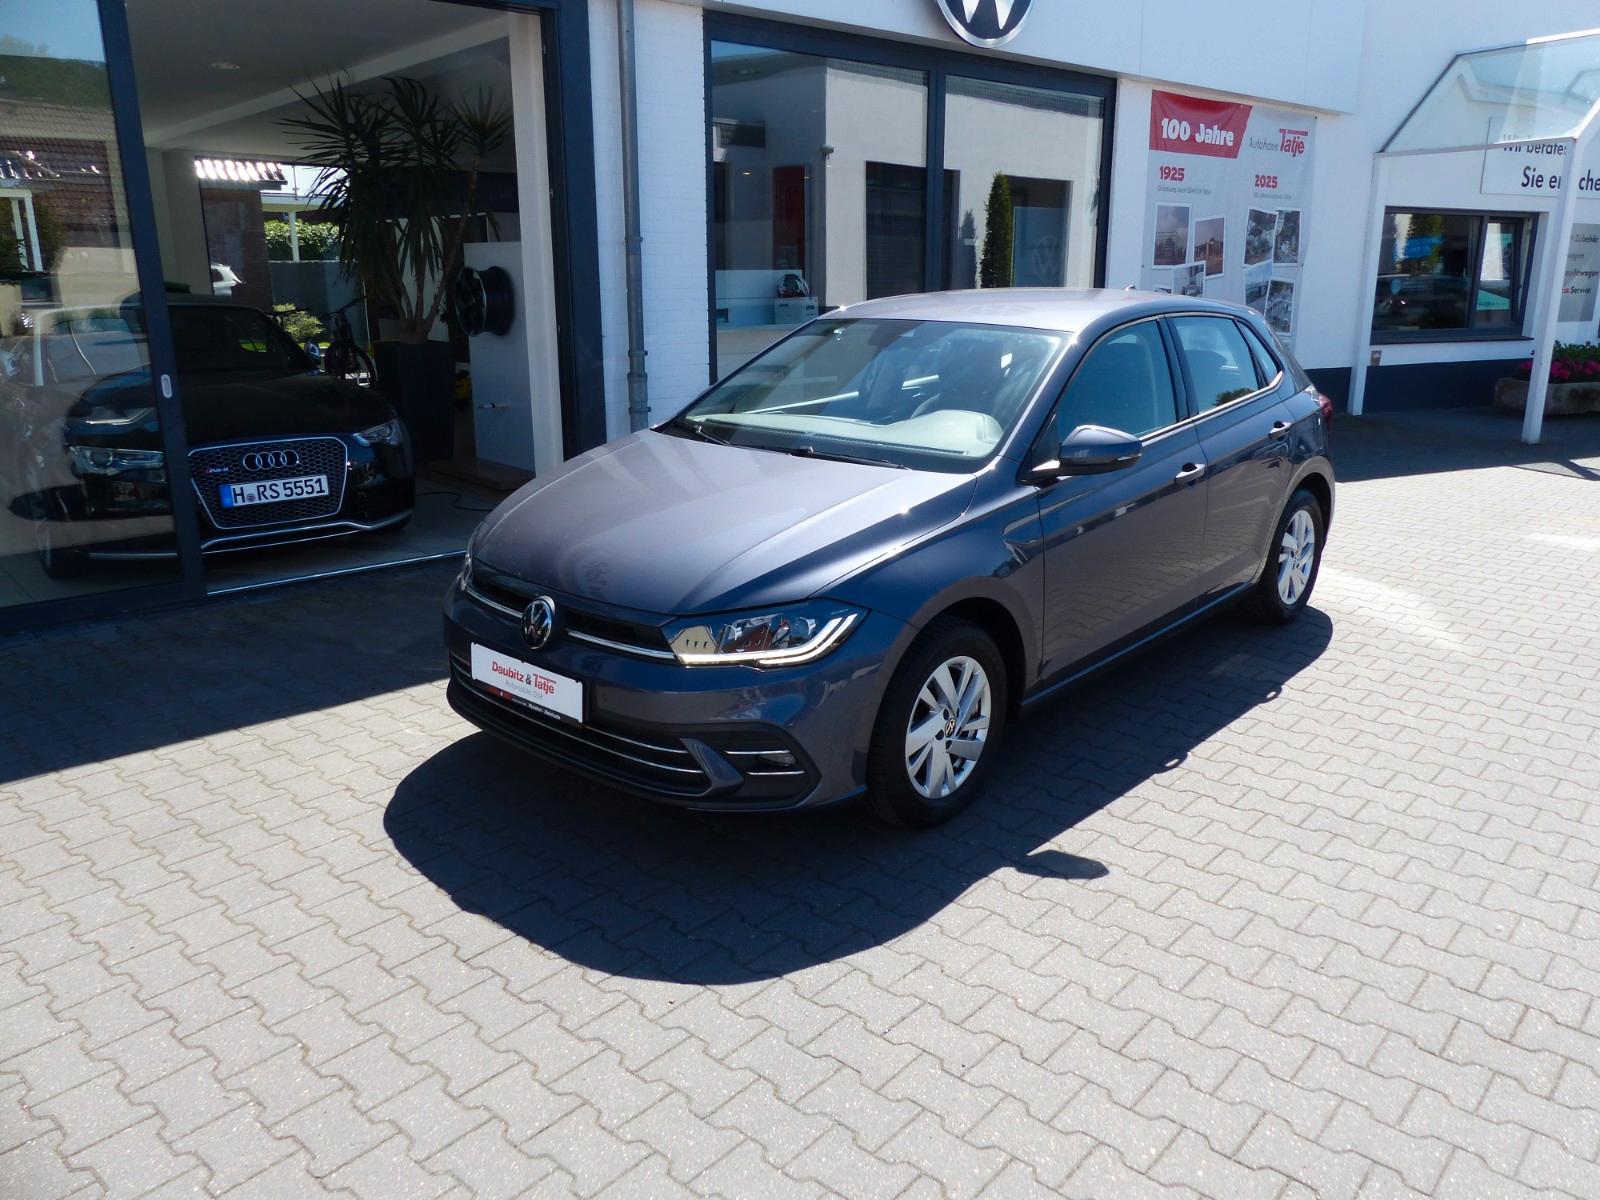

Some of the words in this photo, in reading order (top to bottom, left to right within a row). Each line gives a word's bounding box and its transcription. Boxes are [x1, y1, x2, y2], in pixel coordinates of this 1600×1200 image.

[1161, 117, 1191, 142] 100
[1194, 123, 1234, 147] Jahre
[1279, 128, 1309, 158] Tatje
[1159, 165, 1185, 182] 1925
[1254, 174, 1278, 189] 2025
[1521, 165, 1544, 188] Sie
[233, 485, 246, 504] H
[256, 483, 280, 502] RS
[283, 477, 326, 498] 5551
[491, 660, 525, 683] Daubitz
[525, 673, 532, 686] &
[532, 672, 557, 695] Tatje
